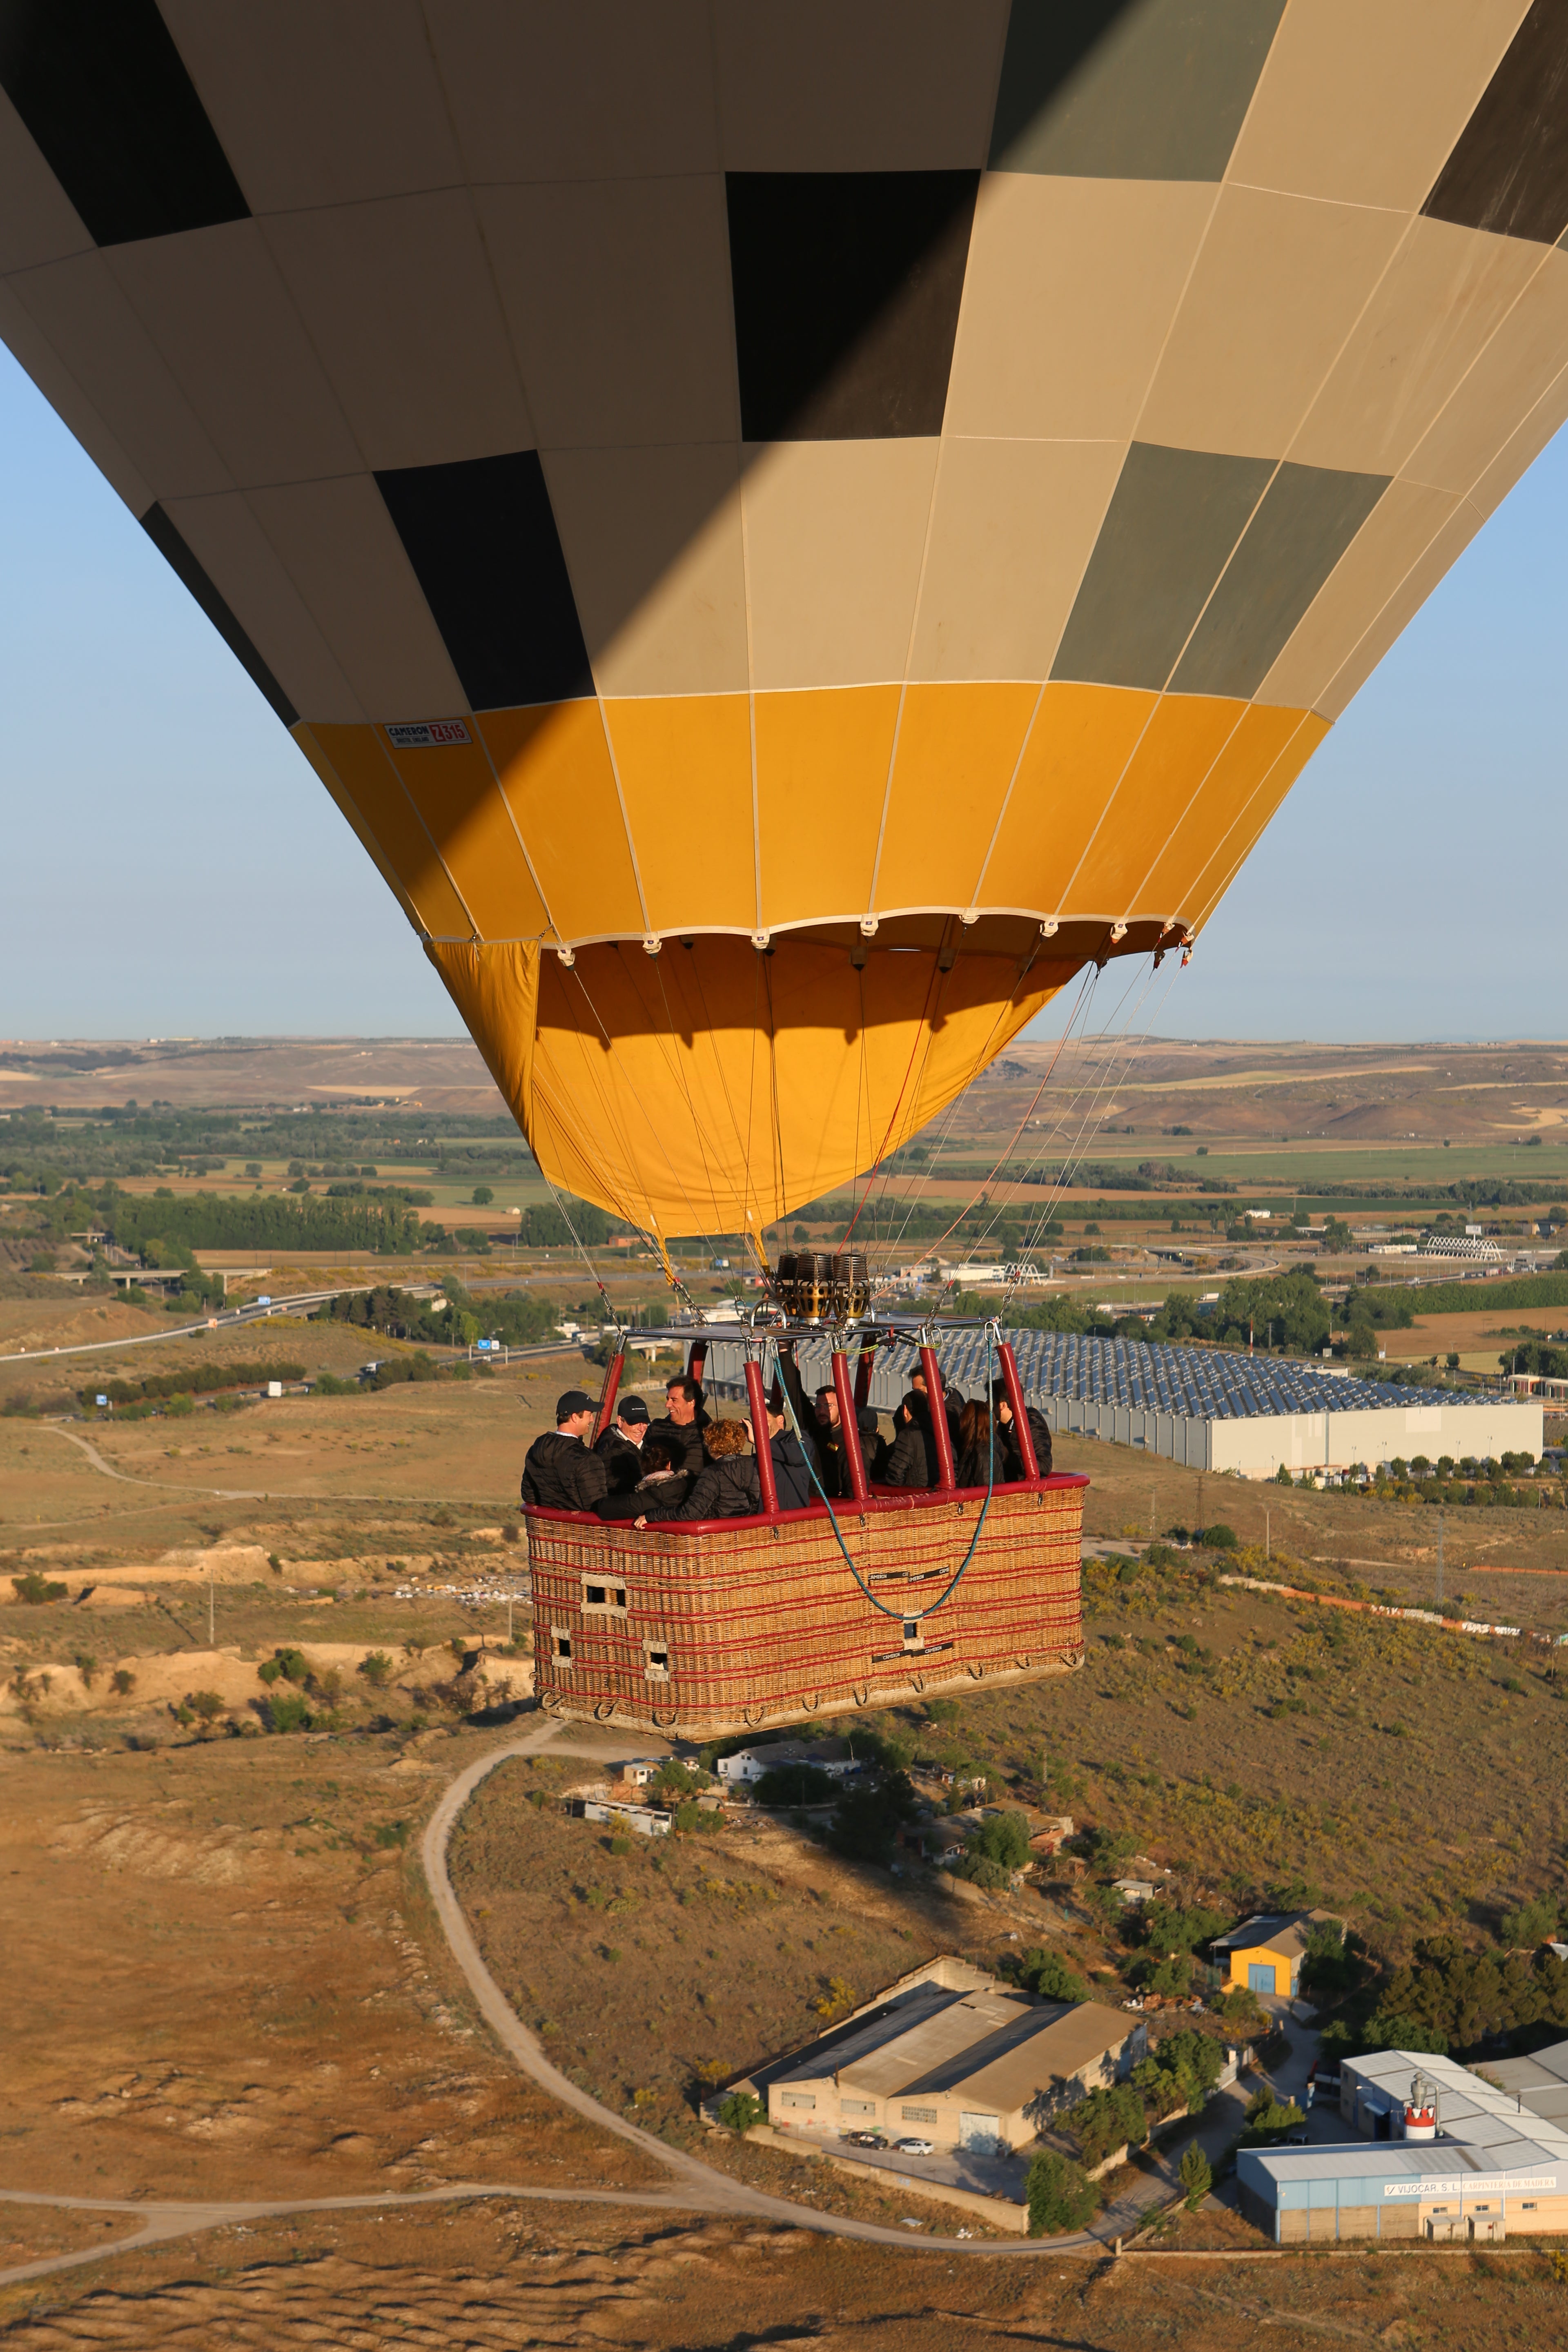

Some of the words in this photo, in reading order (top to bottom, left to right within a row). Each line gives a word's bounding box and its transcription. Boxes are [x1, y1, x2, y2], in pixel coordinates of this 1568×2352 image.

[389, 726, 430, 736] CAMERON
[925, 1646, 942, 1654] CAMERON
[1524, 2179, 1554, 2187] MADERA
